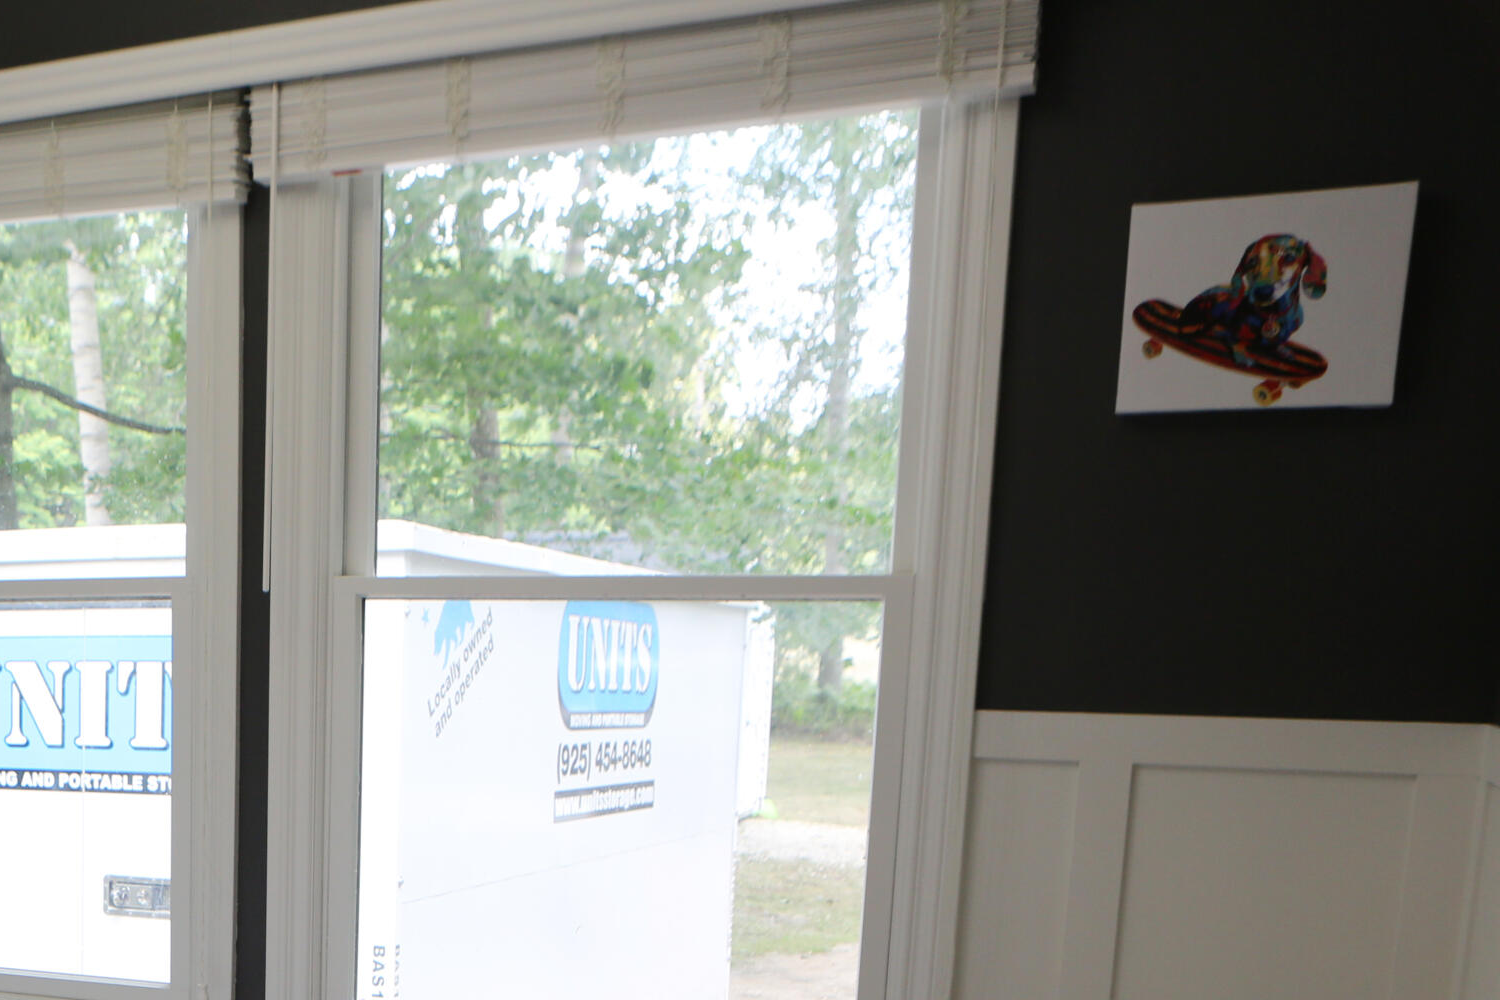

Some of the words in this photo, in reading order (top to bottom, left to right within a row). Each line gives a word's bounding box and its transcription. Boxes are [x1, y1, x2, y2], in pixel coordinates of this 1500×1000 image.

[427, 658, 461, 718] Locally
[463, 605, 493, 662] owned
[435, 697, 453, 738] and
[454, 632, 494, 706] operated
[567, 613, 653, 695] UNITS
[21, 771, 55, 789] AND
[58, 772, 143, 792] PORTABLE
[557, 741, 592, 784] (925)
[595, 738, 652, 773] 454-8648
